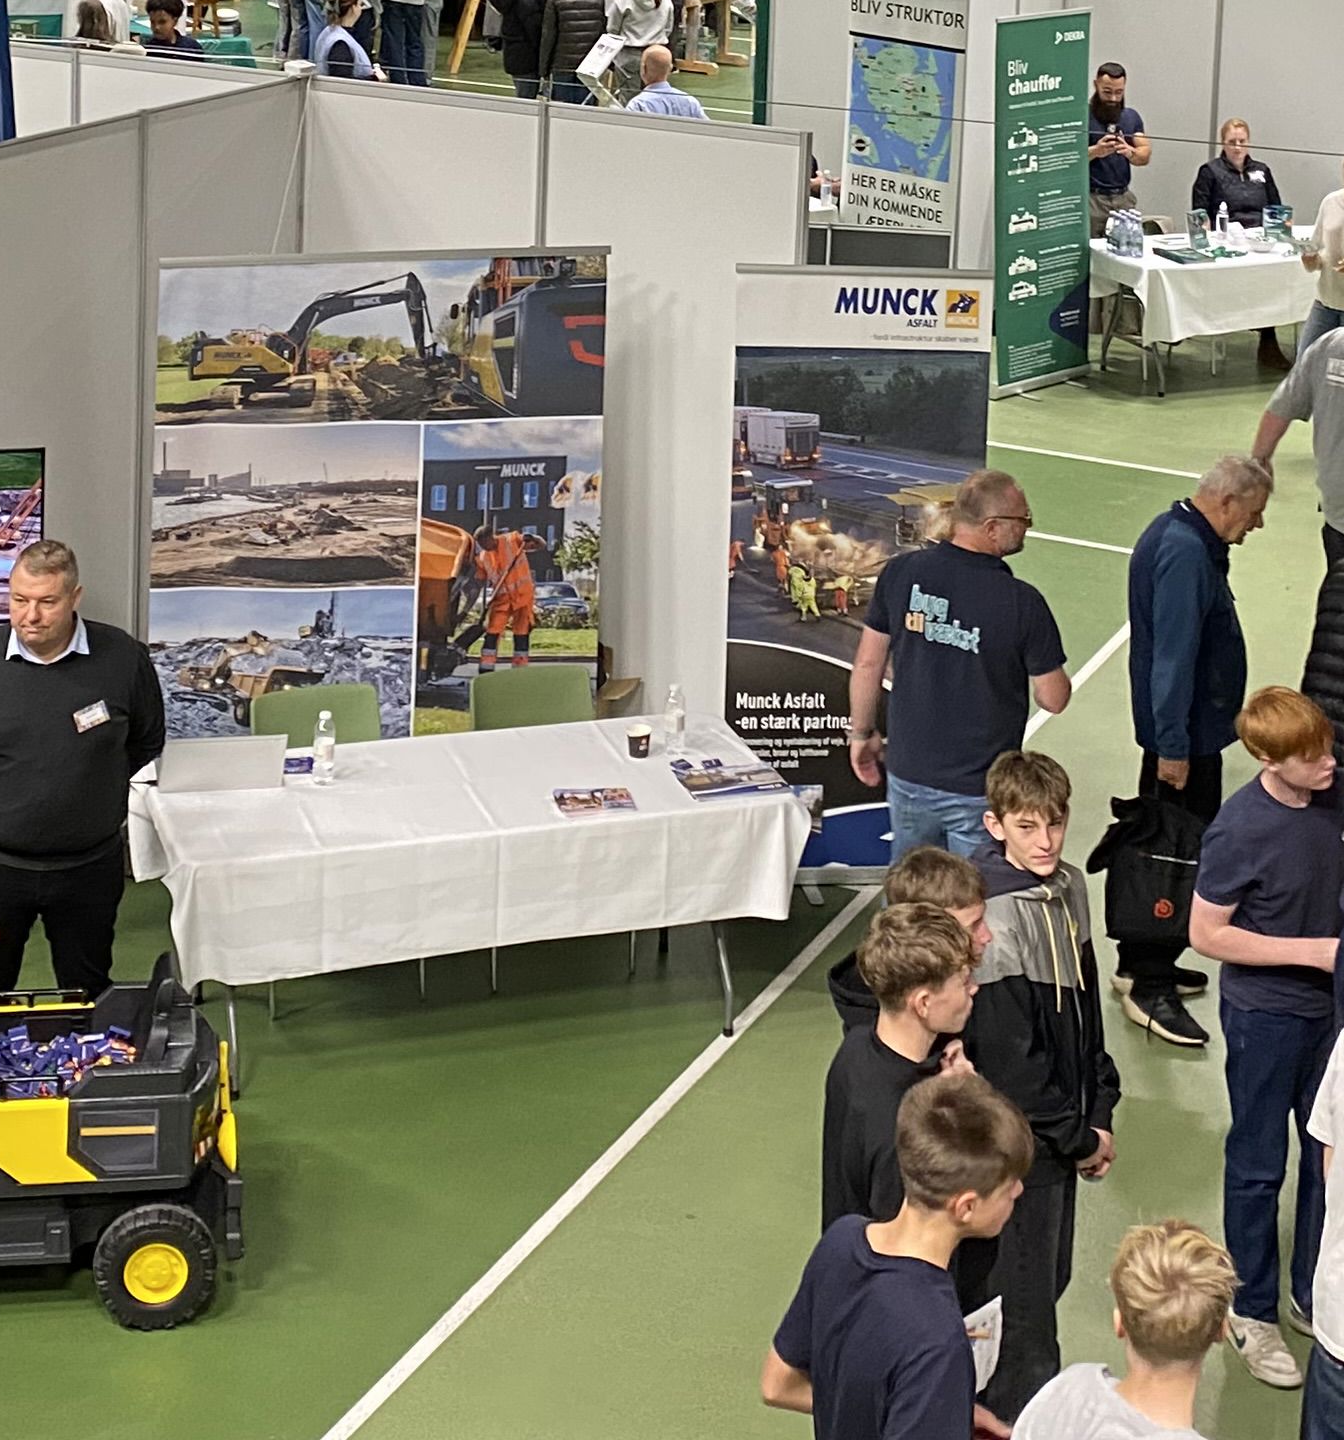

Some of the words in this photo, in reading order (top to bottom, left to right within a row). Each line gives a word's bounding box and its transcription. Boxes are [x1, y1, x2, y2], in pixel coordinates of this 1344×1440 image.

[885, 2, 965, 29] STRUKTØR
[1064, 31, 1085, 42] DEKRA
[1008, 60, 1029, 77] Bliv
[1008, 74, 1062, 96] chauffør
[851, 172, 877, 190] HER
[880, 178, 896, 194] ER
[899, 182, 941, 203] MÅSKE
[848, 192, 869, 208] DIN
[873, 196, 943, 223] KOMMENDE
[834, 287, 939, 316] MUNCK
[906, 318, 939, 328] ASFALT
[500, 462, 546, 477] MUNCK
[736, 692, 782, 709] Munck
[783, 692, 826, 709] Asfalt
[735, 716, 758, 730] -en
[760, 713, 801, 730] stærk
